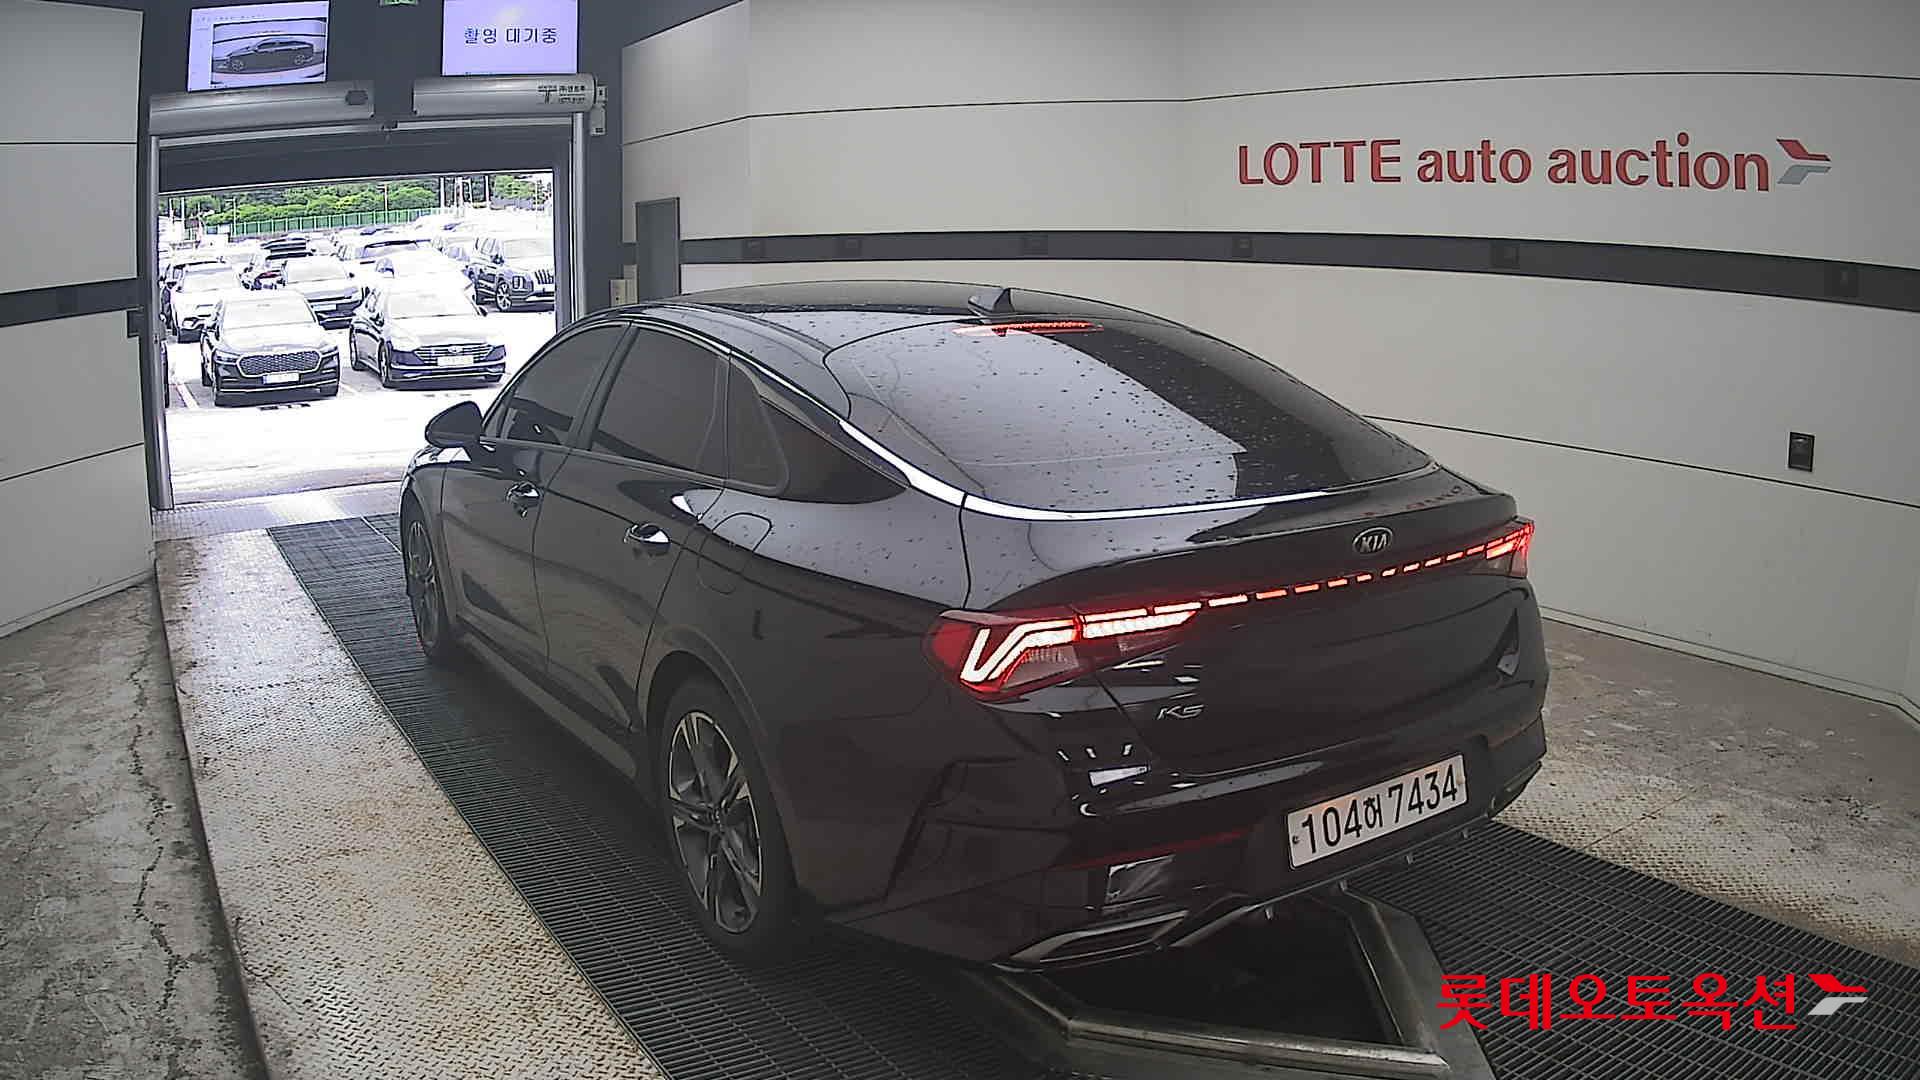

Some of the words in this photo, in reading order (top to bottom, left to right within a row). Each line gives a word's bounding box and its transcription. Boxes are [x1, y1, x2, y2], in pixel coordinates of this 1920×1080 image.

[465, 27, 497, 44] 촬영
[505, 27, 557, 44] 대기중
[1238, 139, 1402, 186] LOTTE
[1416, 139, 1532, 185] auto
[1547, 131, 1771, 193] auction
[1359, 532, 1391, 553] KIA
[1157, 704, 1204, 720] K5
[1387, 764, 1458, 824] 7434
